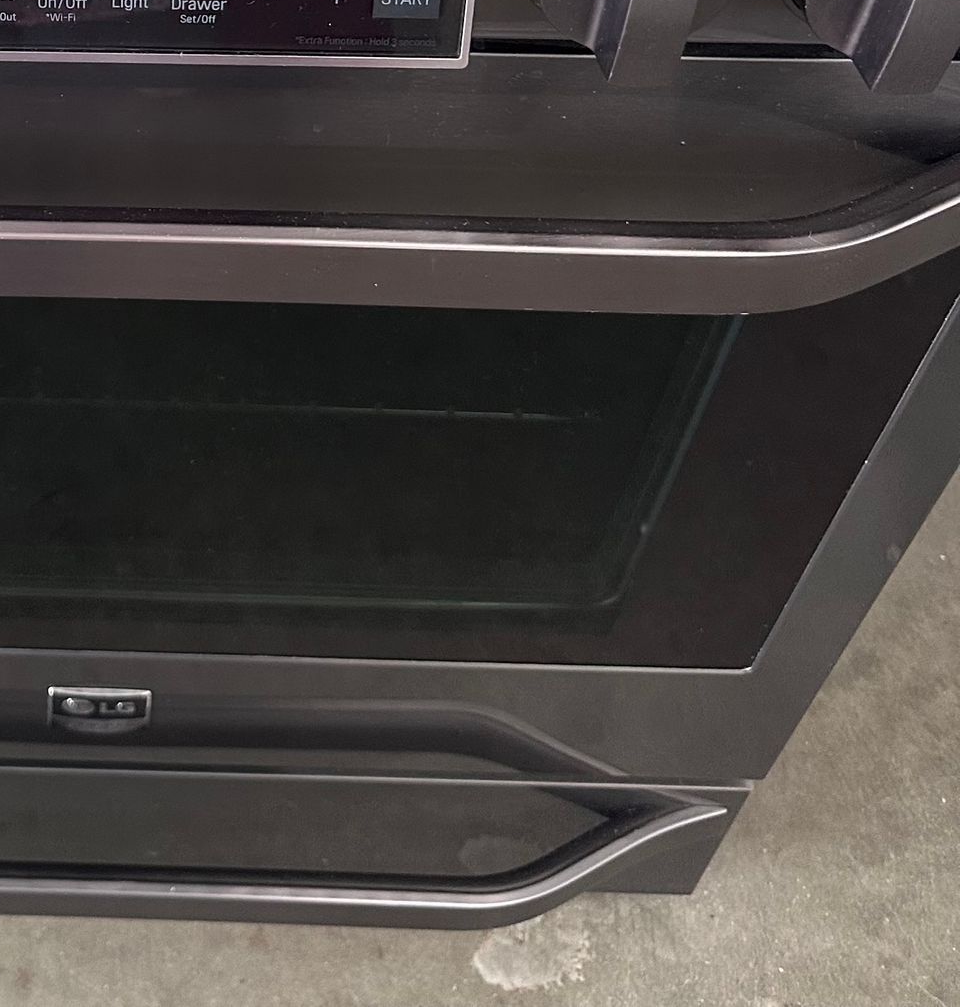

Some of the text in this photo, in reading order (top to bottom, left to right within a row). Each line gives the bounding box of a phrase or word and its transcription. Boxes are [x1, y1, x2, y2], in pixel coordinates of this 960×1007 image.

[0, 12, 17, 22] Out
[179, 14, 216, 24] Set/Off
[100, 701, 136, 713] LG
